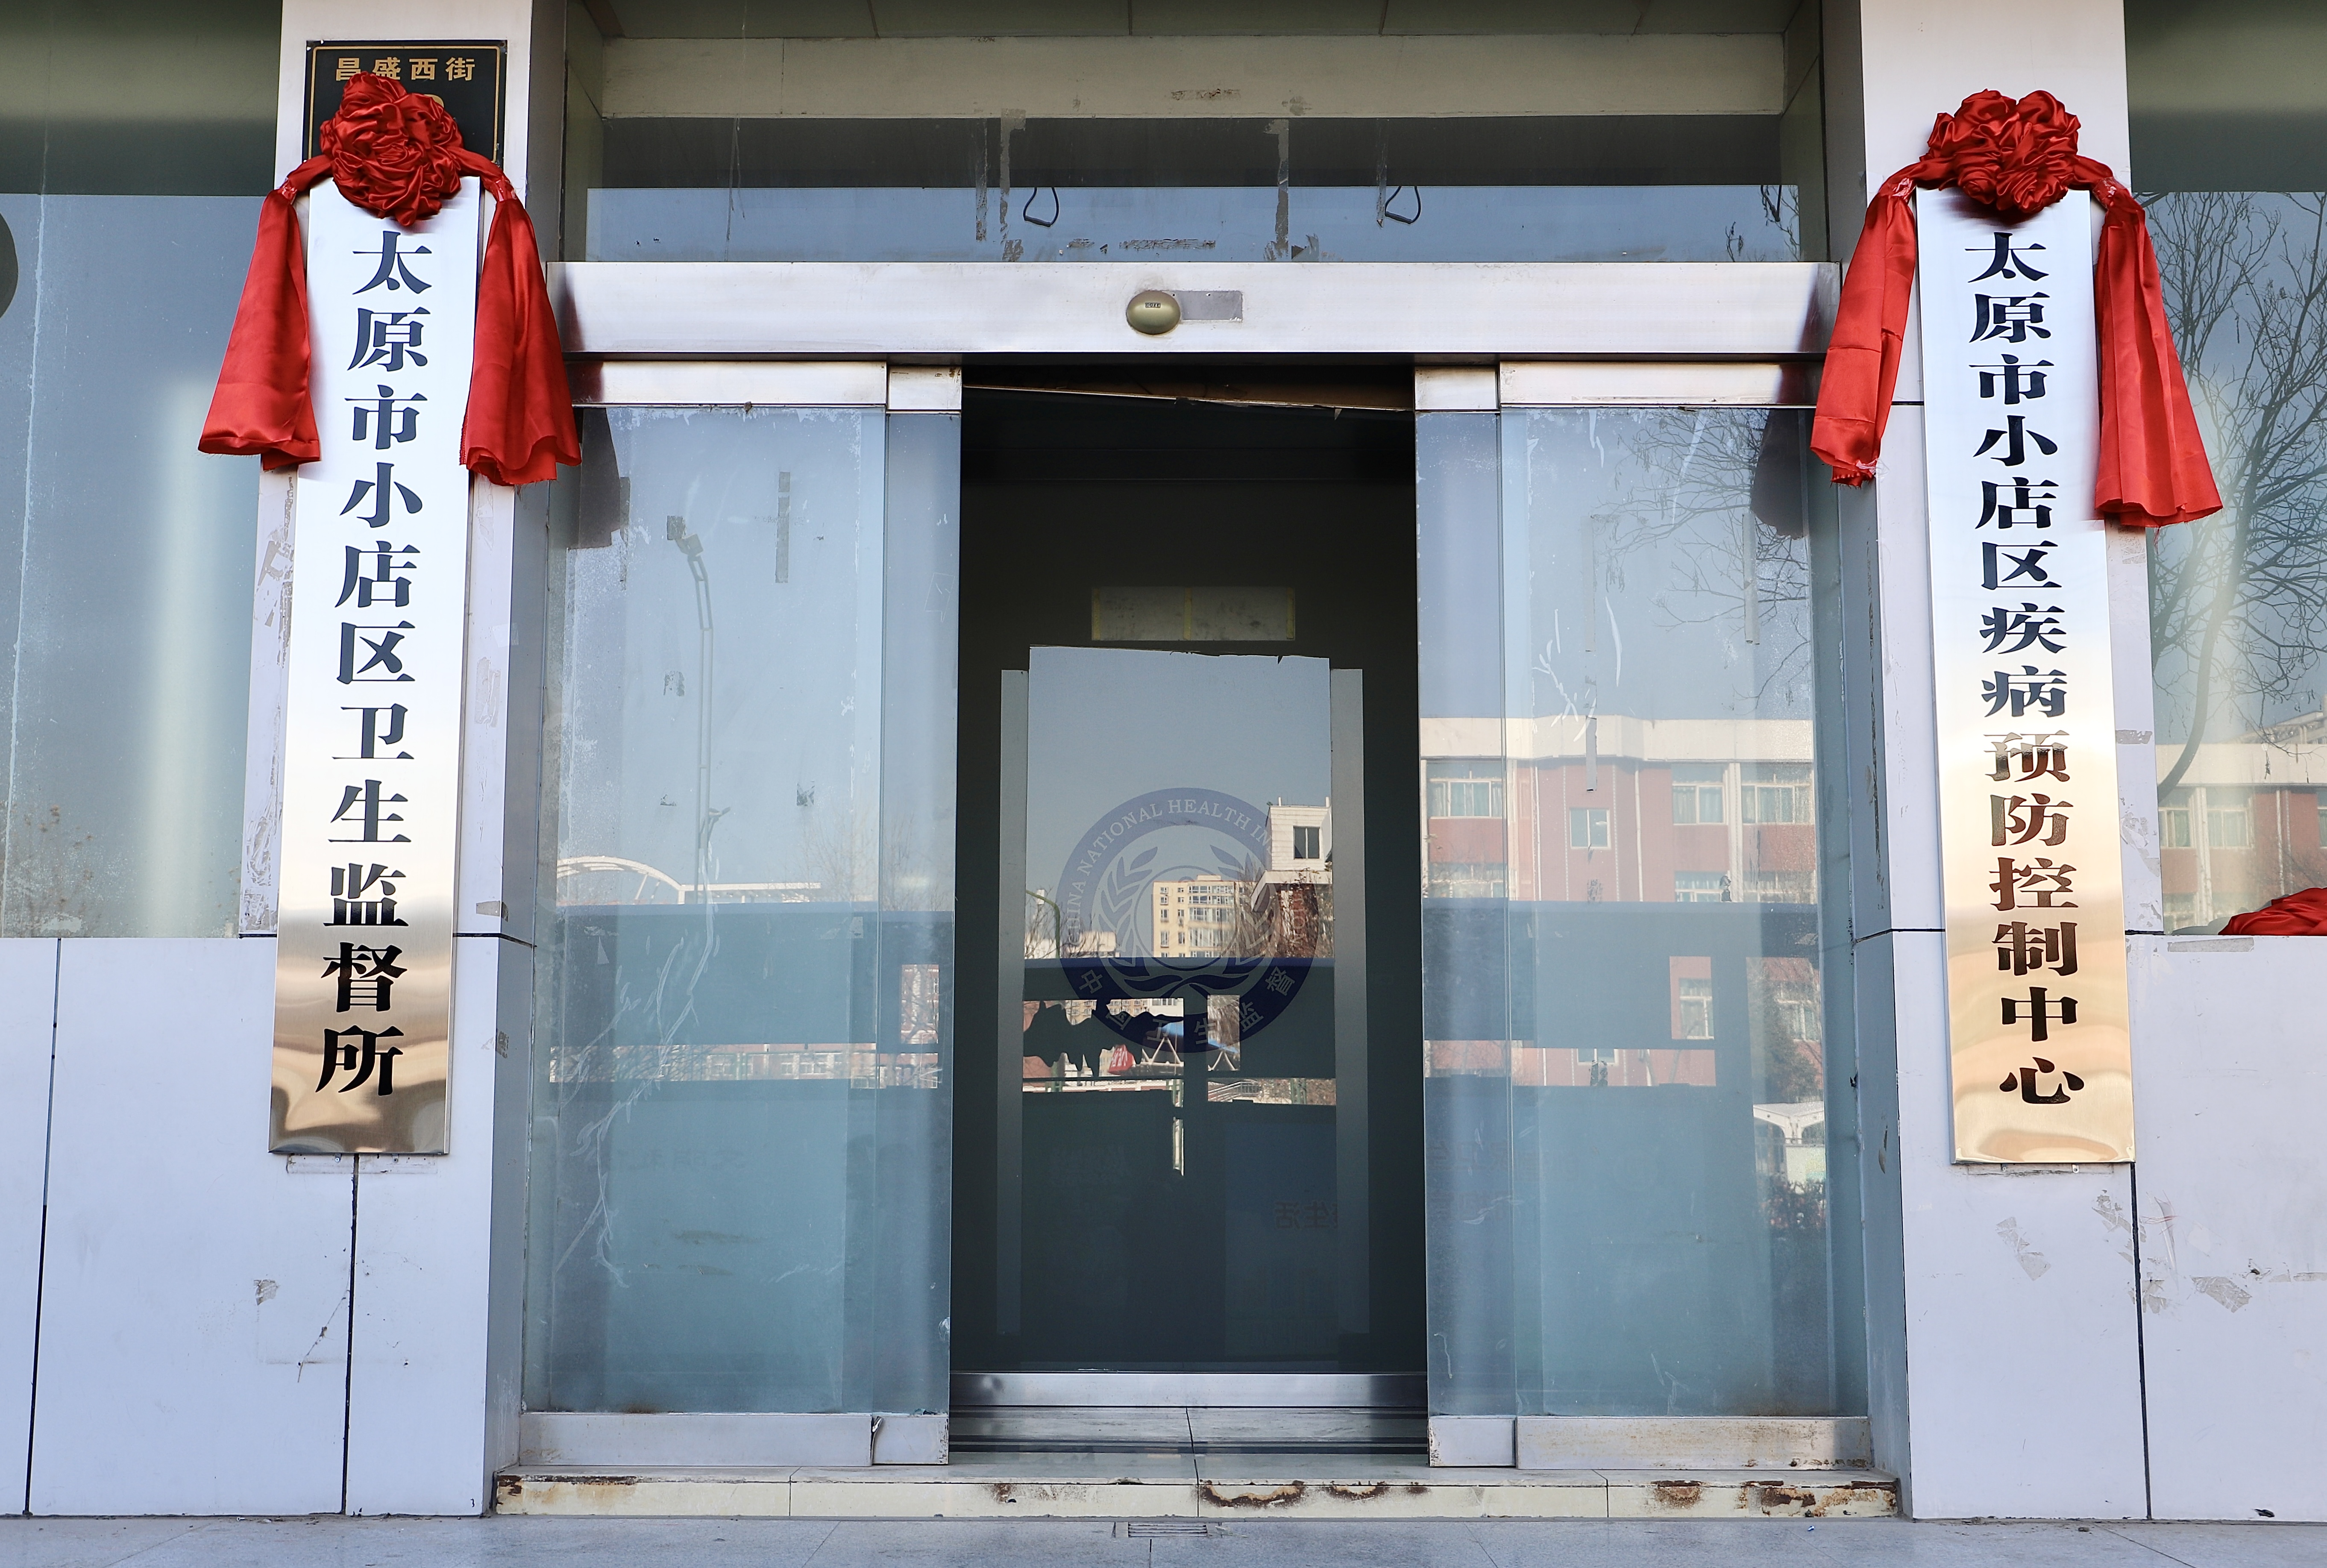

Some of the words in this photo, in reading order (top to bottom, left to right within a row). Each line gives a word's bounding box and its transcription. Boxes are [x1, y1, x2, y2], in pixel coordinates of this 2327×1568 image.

[335, 56, 475, 81] 昌盛西街
[316, 230, 432, 1095] 太原市小店区卫生监督所
[1079, 802, 1162, 876] NATIONAL
[1168, 799, 1253, 831] HEALTH
[1965, 232, 2084, 1105] 太原市小店区疾病预防控制中心
